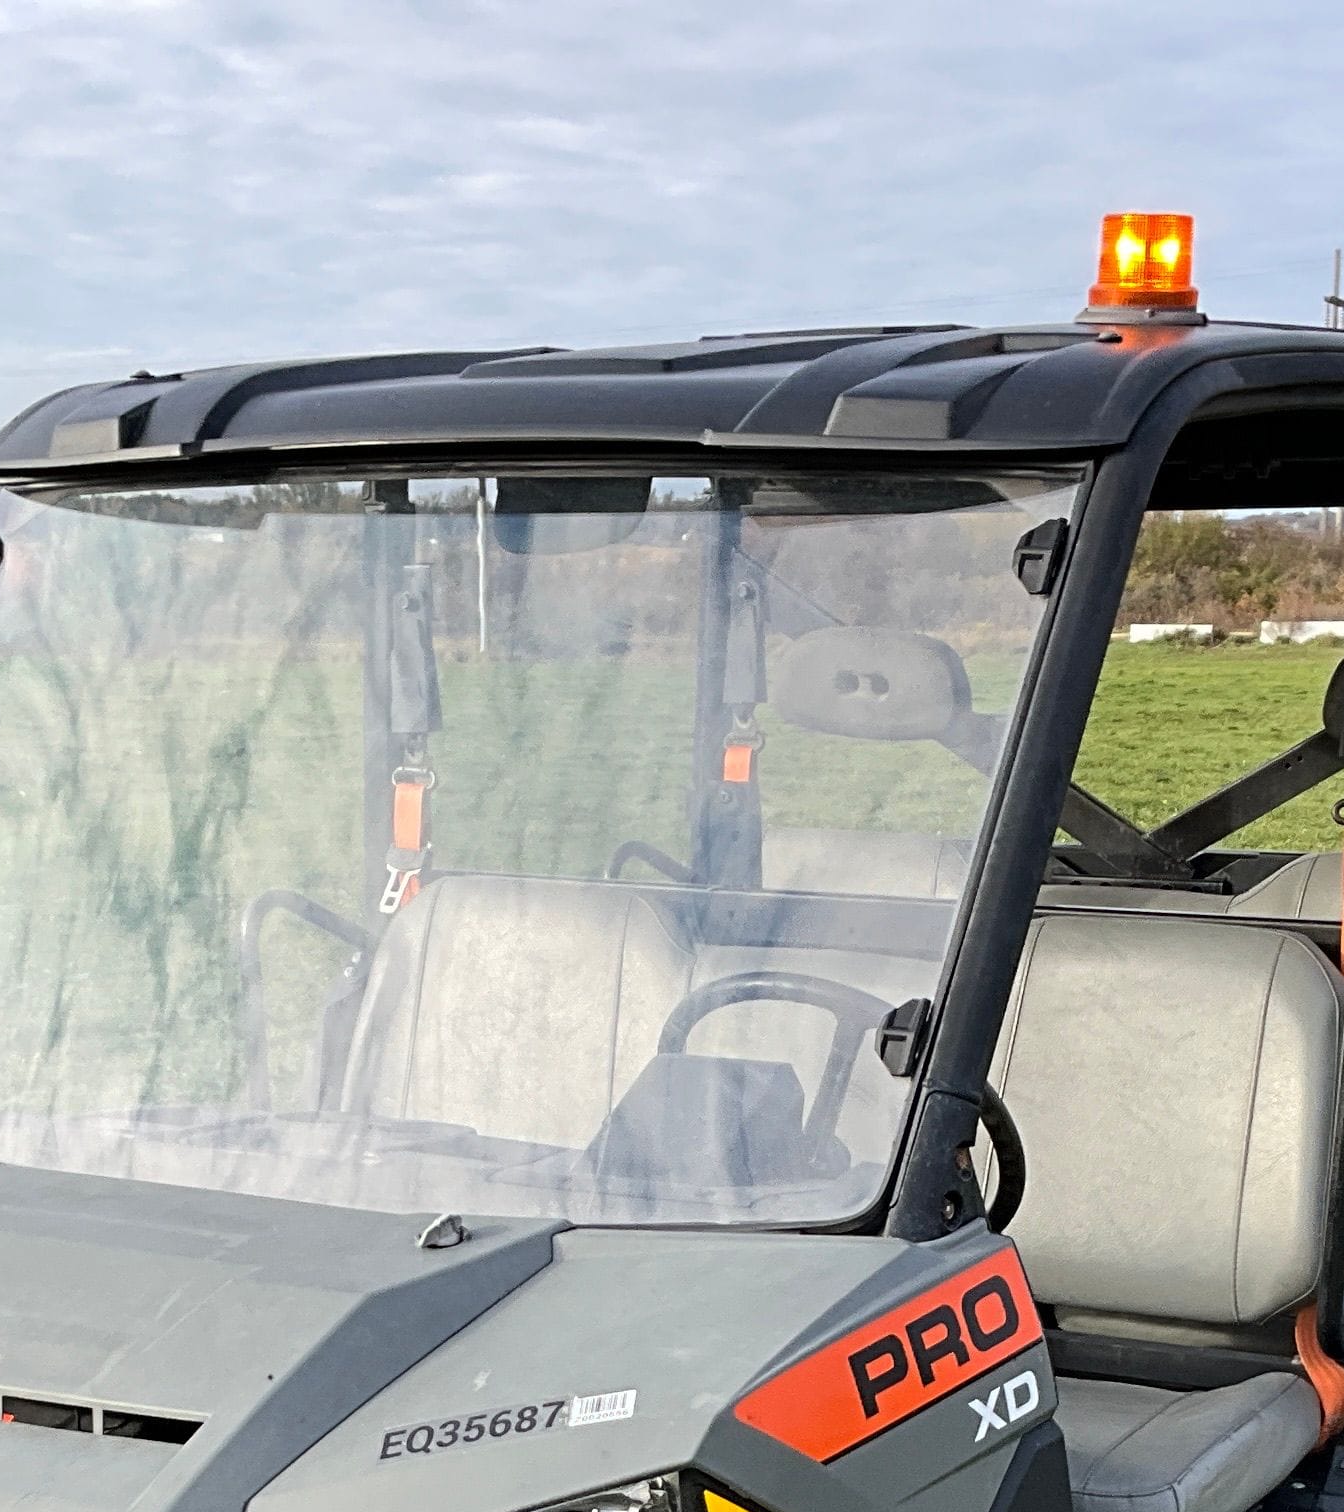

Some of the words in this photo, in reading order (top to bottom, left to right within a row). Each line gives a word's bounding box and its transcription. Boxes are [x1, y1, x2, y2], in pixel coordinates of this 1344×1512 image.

[848, 1275, 1019, 1420] PRO
[379, 1400, 566, 1460] EQ35687
[967, 1370, 1040, 1443] XD
